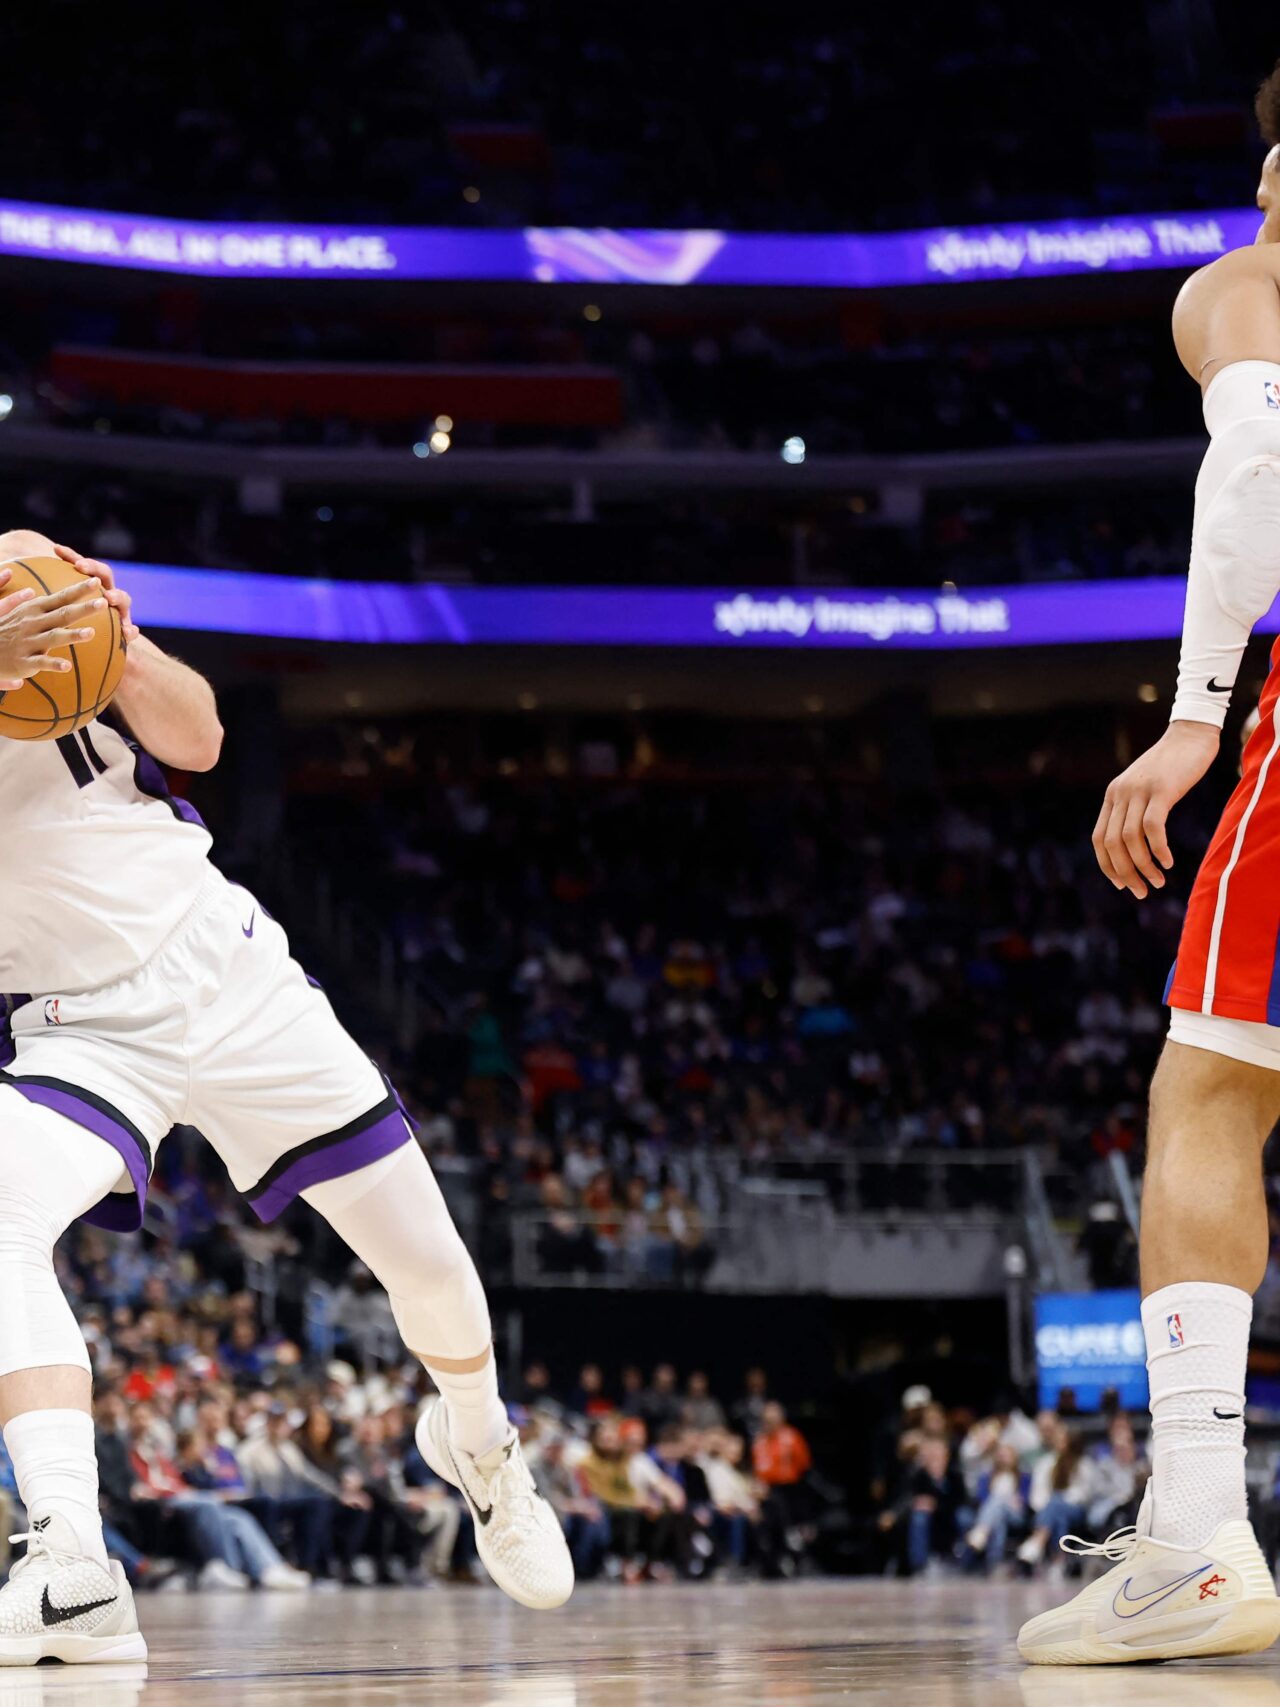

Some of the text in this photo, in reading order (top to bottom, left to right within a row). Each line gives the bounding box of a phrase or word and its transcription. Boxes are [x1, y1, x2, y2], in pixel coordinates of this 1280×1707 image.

[127, 227, 181, 264] ALL
[181, 230, 218, 266] IN
[219, 233, 286, 269] ONE
[1024, 223, 1152, 269] Imagine
[1151, 218, 1224, 256] That
[714, 593, 1009, 641] xfinity Imagine That
